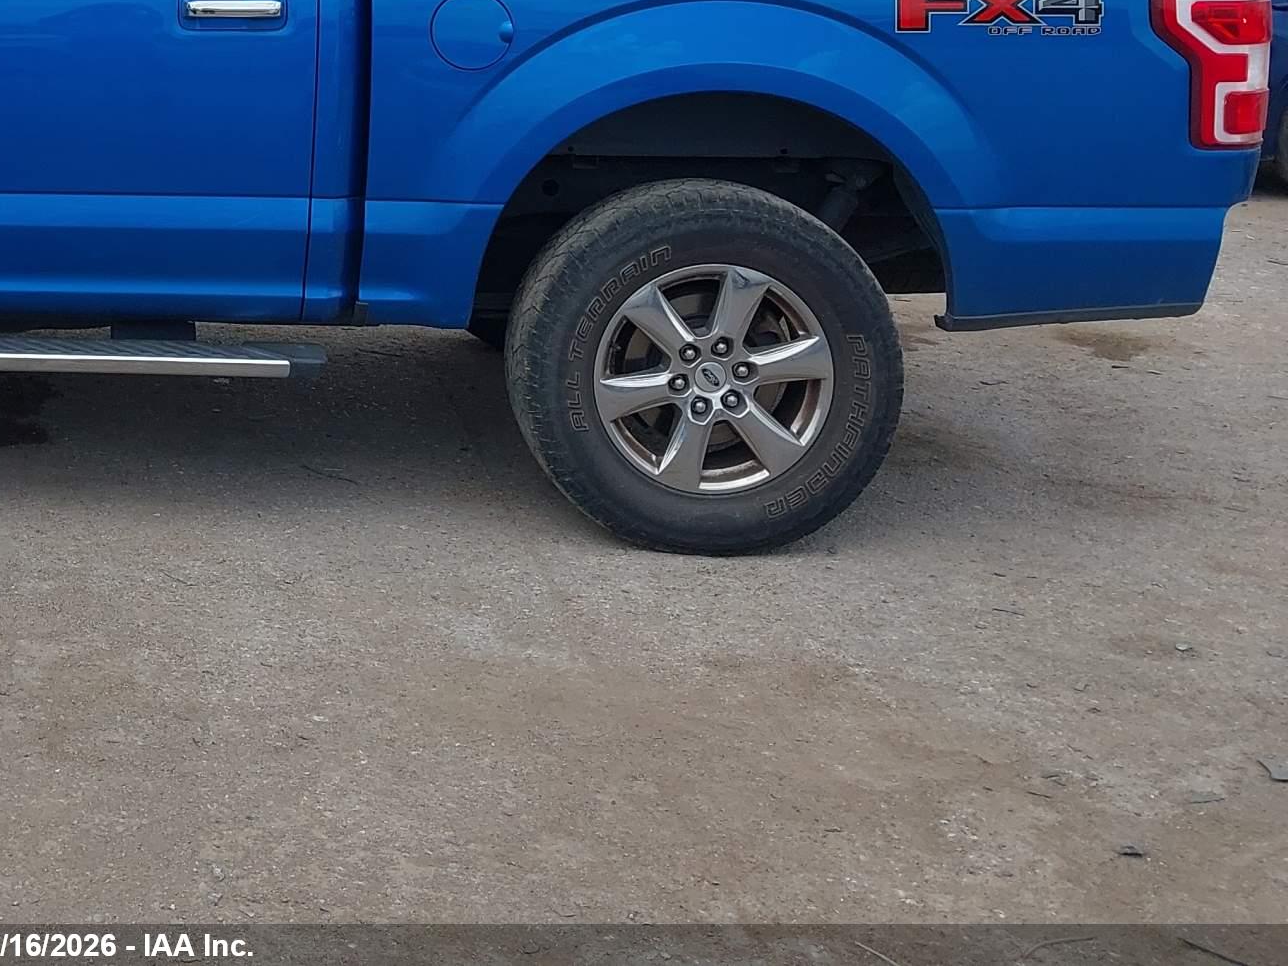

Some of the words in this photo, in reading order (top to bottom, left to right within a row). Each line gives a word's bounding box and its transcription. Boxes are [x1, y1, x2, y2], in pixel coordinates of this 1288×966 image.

[987, 26, 1033, 36] OFF
[1040, 26, 1102, 36] ROAD
[568, 245, 672, 363] TERRAIN
[567, 371, 590, 433] ALL
[765, 334, 872, 518] PATHFINDER
